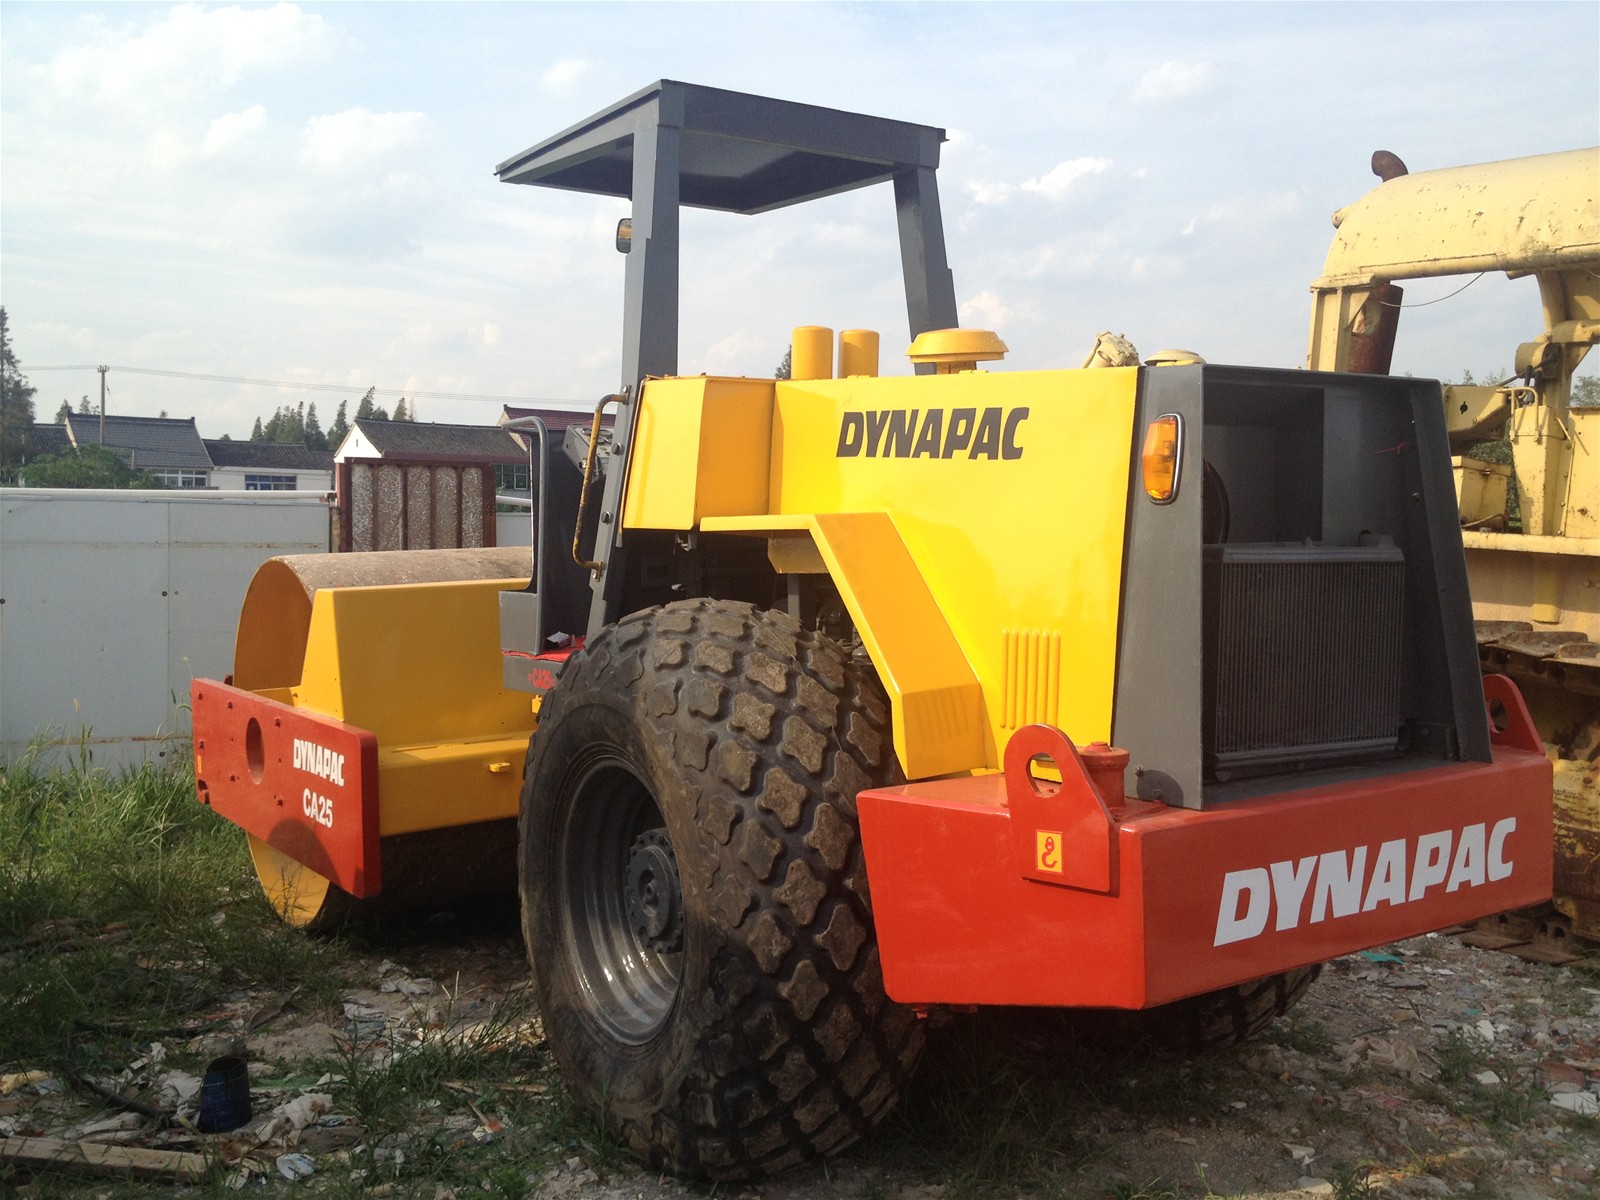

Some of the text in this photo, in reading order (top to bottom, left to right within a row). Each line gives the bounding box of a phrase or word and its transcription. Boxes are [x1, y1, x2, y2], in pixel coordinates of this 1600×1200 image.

[836, 407, 1029, 460] DYNAPAC
[293, 738, 345, 787] DYNAPAC
[303, 788, 333, 828] CA25
[1213, 817, 1517, 948] DYNAPAC
